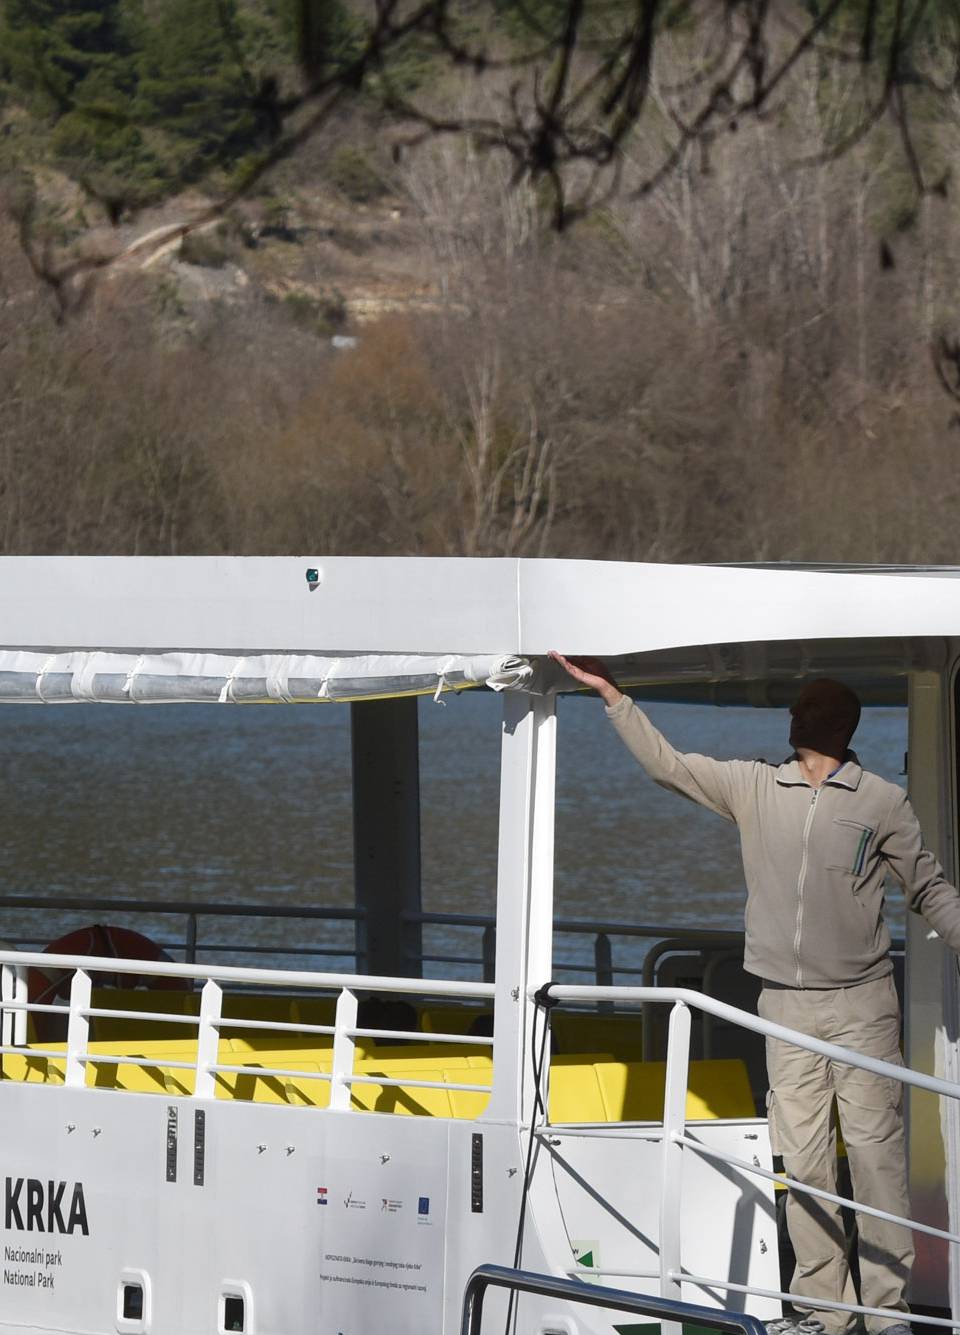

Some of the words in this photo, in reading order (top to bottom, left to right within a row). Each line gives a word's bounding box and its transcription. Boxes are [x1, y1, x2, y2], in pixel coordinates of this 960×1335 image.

[5, 1177, 90, 1236] KRKA
[4, 1246, 44, 1264] Nacionalni
[45, 1250, 62, 1269] park
[3, 1268, 36, 1287] National
[37, 1272, 55, 1289] Park
